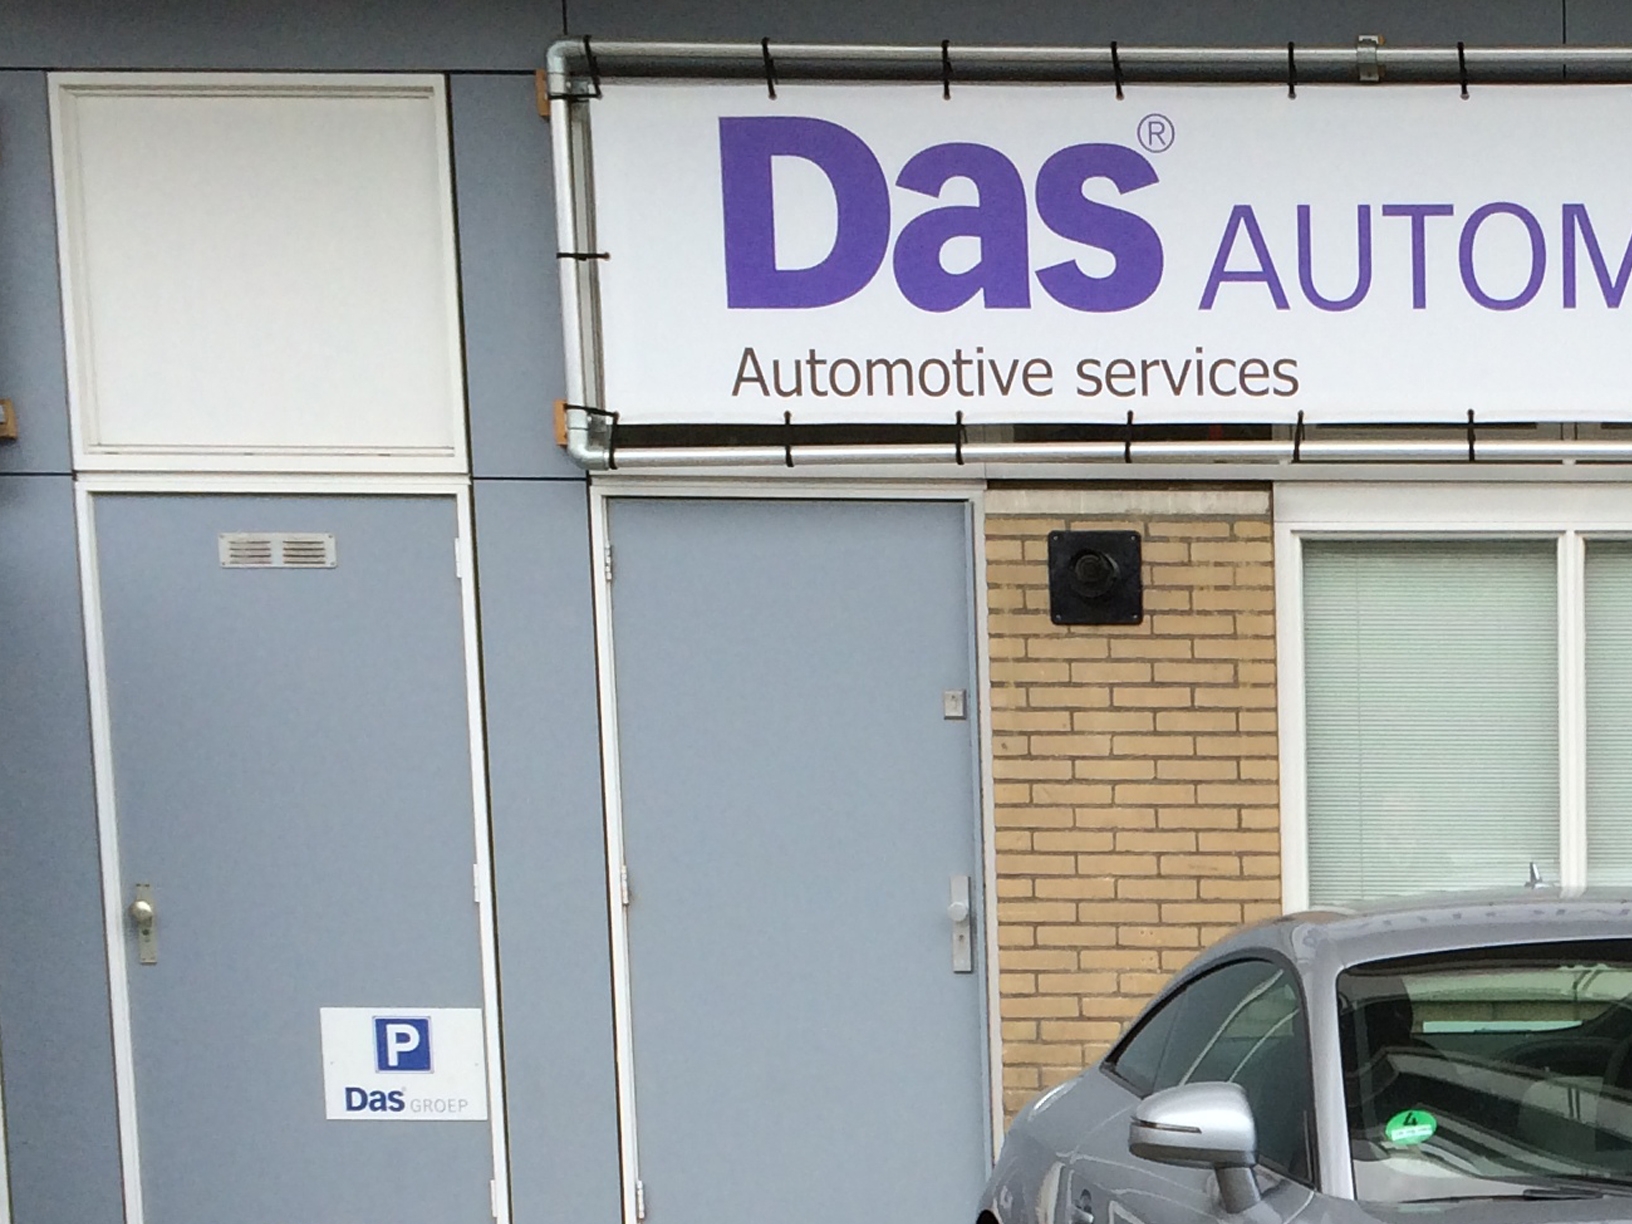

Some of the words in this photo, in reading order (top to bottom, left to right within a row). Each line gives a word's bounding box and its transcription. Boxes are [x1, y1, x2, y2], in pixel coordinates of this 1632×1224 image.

[732, 346, 1053, 398] Automotive
[1076, 346, 1299, 398] services
[386, 1023, 420, 1067] P
[410, 1098, 468, 1113] GROEP
